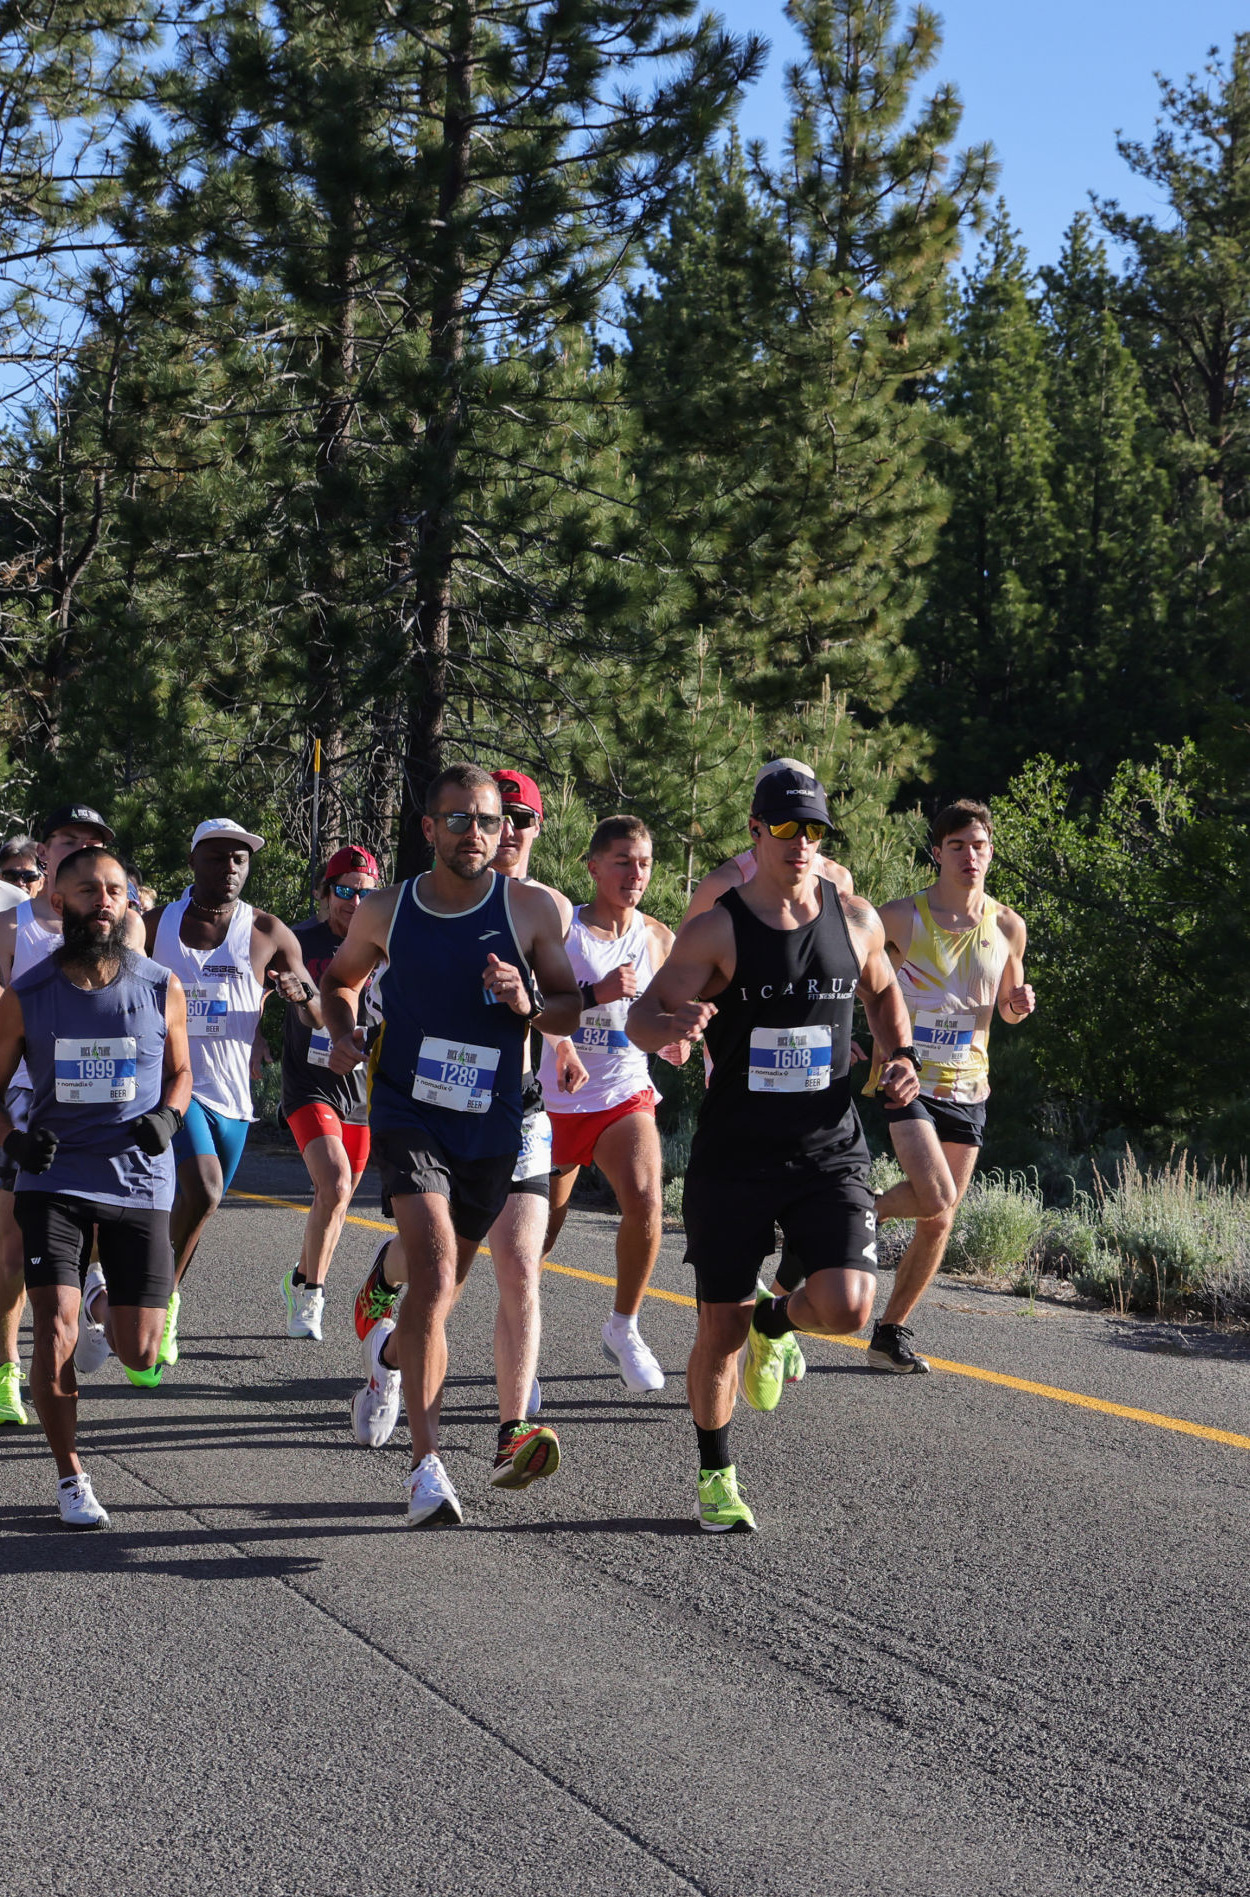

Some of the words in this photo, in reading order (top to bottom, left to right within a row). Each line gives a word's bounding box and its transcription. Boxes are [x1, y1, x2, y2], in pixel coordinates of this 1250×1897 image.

[786, 789, 816, 798] ROGUE
[203, 965, 243, 975] REBEL
[740, 978, 858, 1000] ICARUS
[187, 1001, 211, 1016] 607
[206, 1025, 220, 1033] BEER
[582, 1028, 610, 1047] 934
[930, 1029, 959, 1045] 1271
[772, 1048, 813, 1068] 1608
[76, 1060, 116, 1078] 1999
[754, 1069, 783, 1077] nomadix
[440, 1063, 479, 1088] 1289
[61, 1080, 88, 1088] nomadix
[420, 1080, 448, 1092] nomadix
[804, 1078, 821, 1088] BEER
[110, 1089, 127, 1098] BEER
[466, 1100, 483, 1110] BEER
